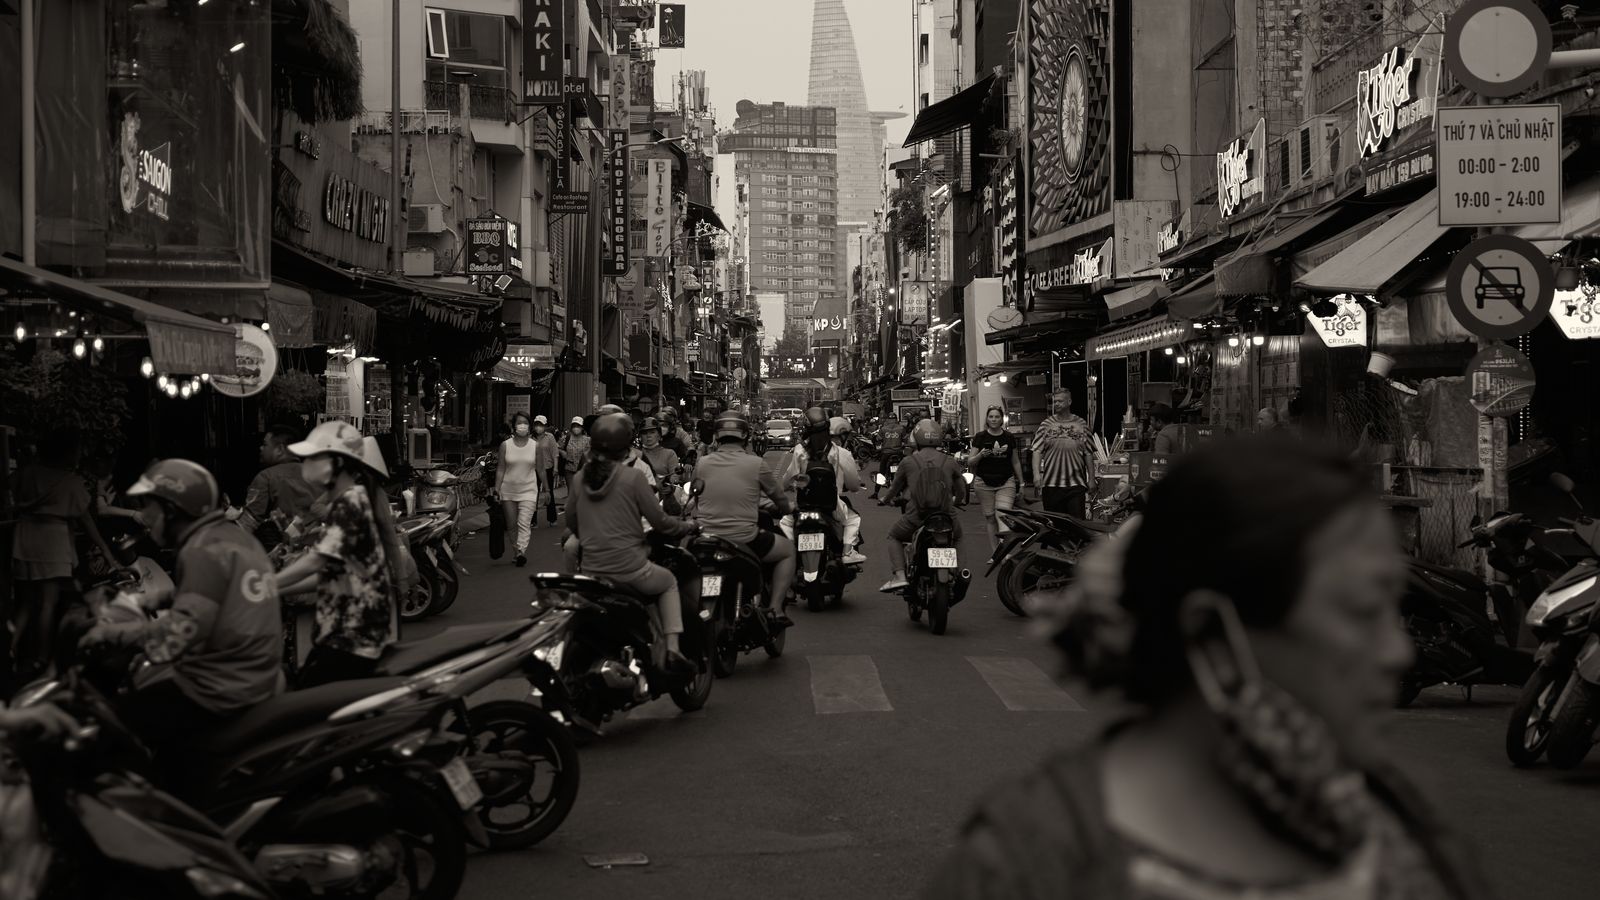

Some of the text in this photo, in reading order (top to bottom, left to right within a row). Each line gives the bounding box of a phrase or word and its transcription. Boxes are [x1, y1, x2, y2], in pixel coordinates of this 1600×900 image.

[613, 58, 629, 126] HAPPY
[1369, 46, 1414, 138] Tiger
[1443, 117, 1555, 141] THỨ 7 VÀ CHỦ NHẬT
[143, 150, 172, 196] SAIGON
[1459, 158, 1495, 174] 00:00
[1511, 156, 1539, 173] 2:00
[325, 171, 360, 233] CRAZY
[360, 189, 390, 243] NIGHT
[614, 133, 624, 270] HAIR OF THE DOG BAR
[1455, 191, 1489, 208] 19:00
[1507, 190, 1544, 207] 24:00
[472, 231, 500, 247] BBQ
[1322, 317, 1361, 337] Tiger
[884, 431, 900, 440] Grab
